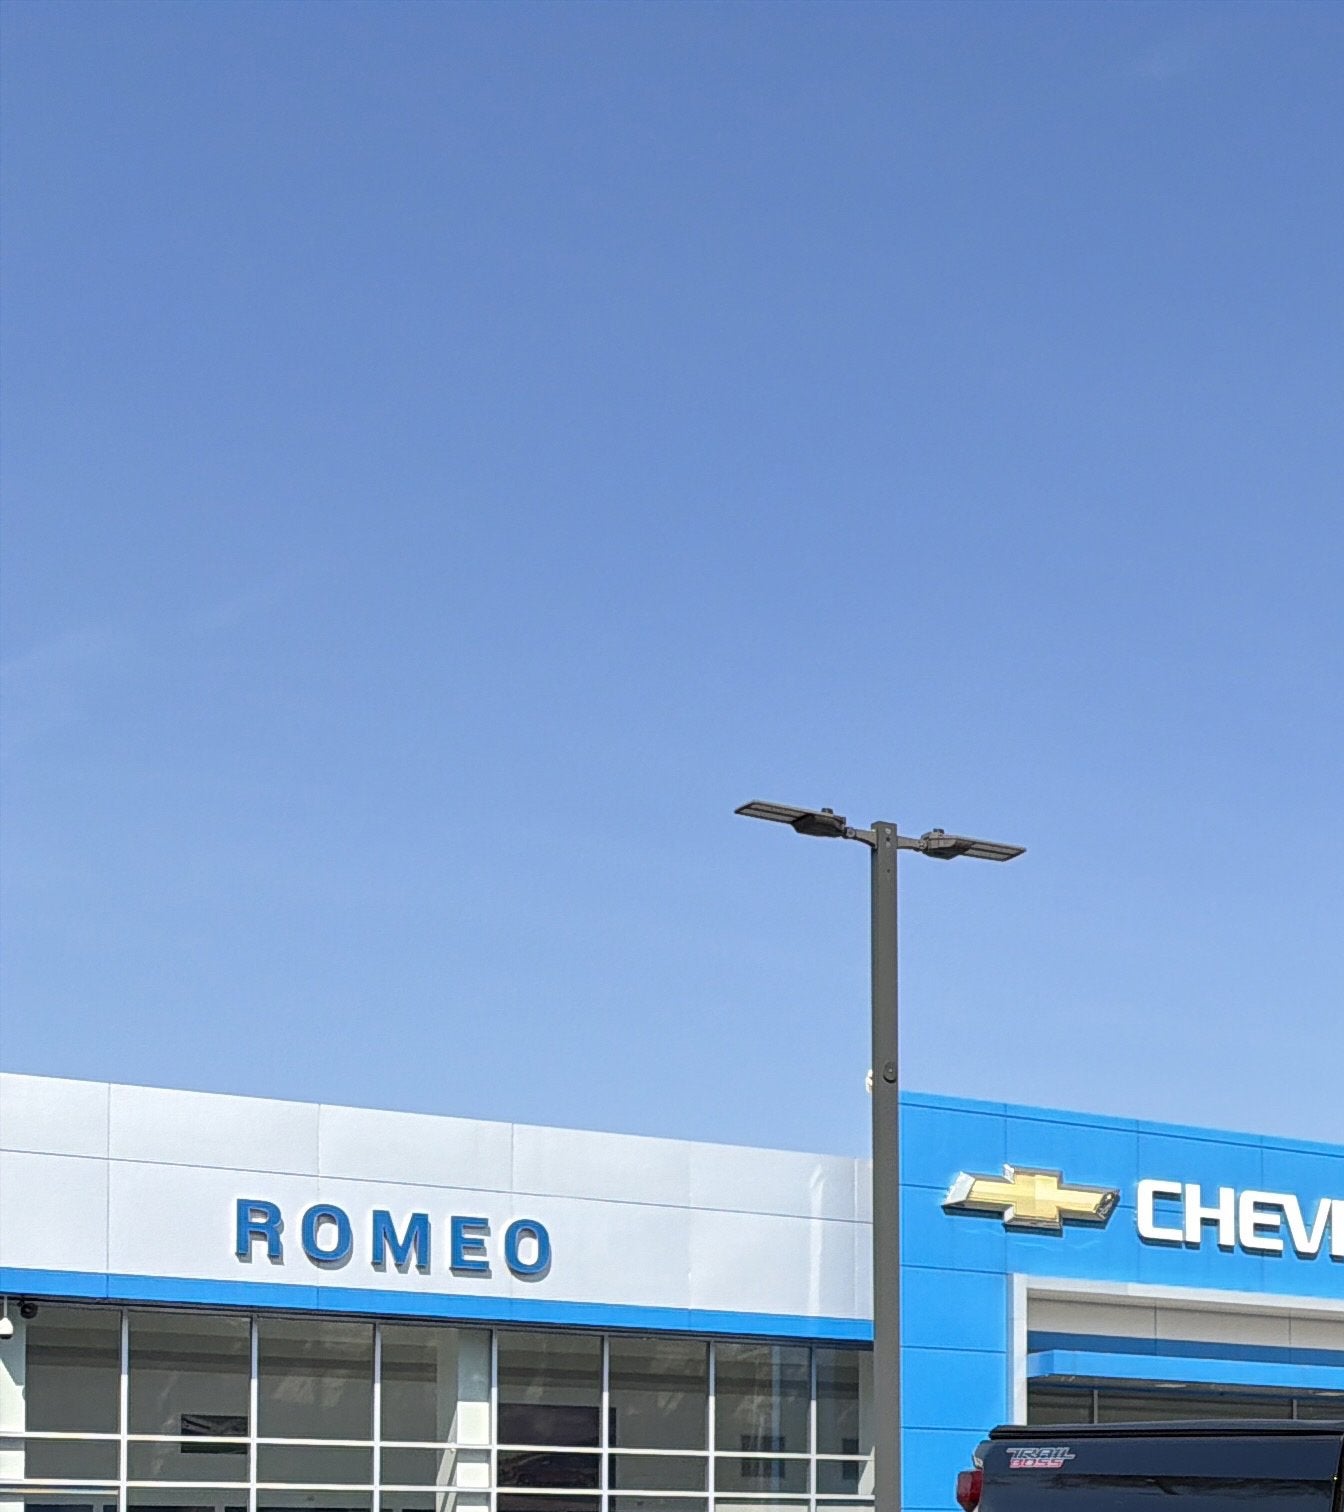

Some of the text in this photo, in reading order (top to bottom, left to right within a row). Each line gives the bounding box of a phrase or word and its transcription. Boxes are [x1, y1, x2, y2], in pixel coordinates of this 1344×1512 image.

[235, 1198, 552, 1276] ROMEO
[1006, 1446, 1076, 1460] TRAIL
[1009, 1458, 1065, 1469] BOSS
